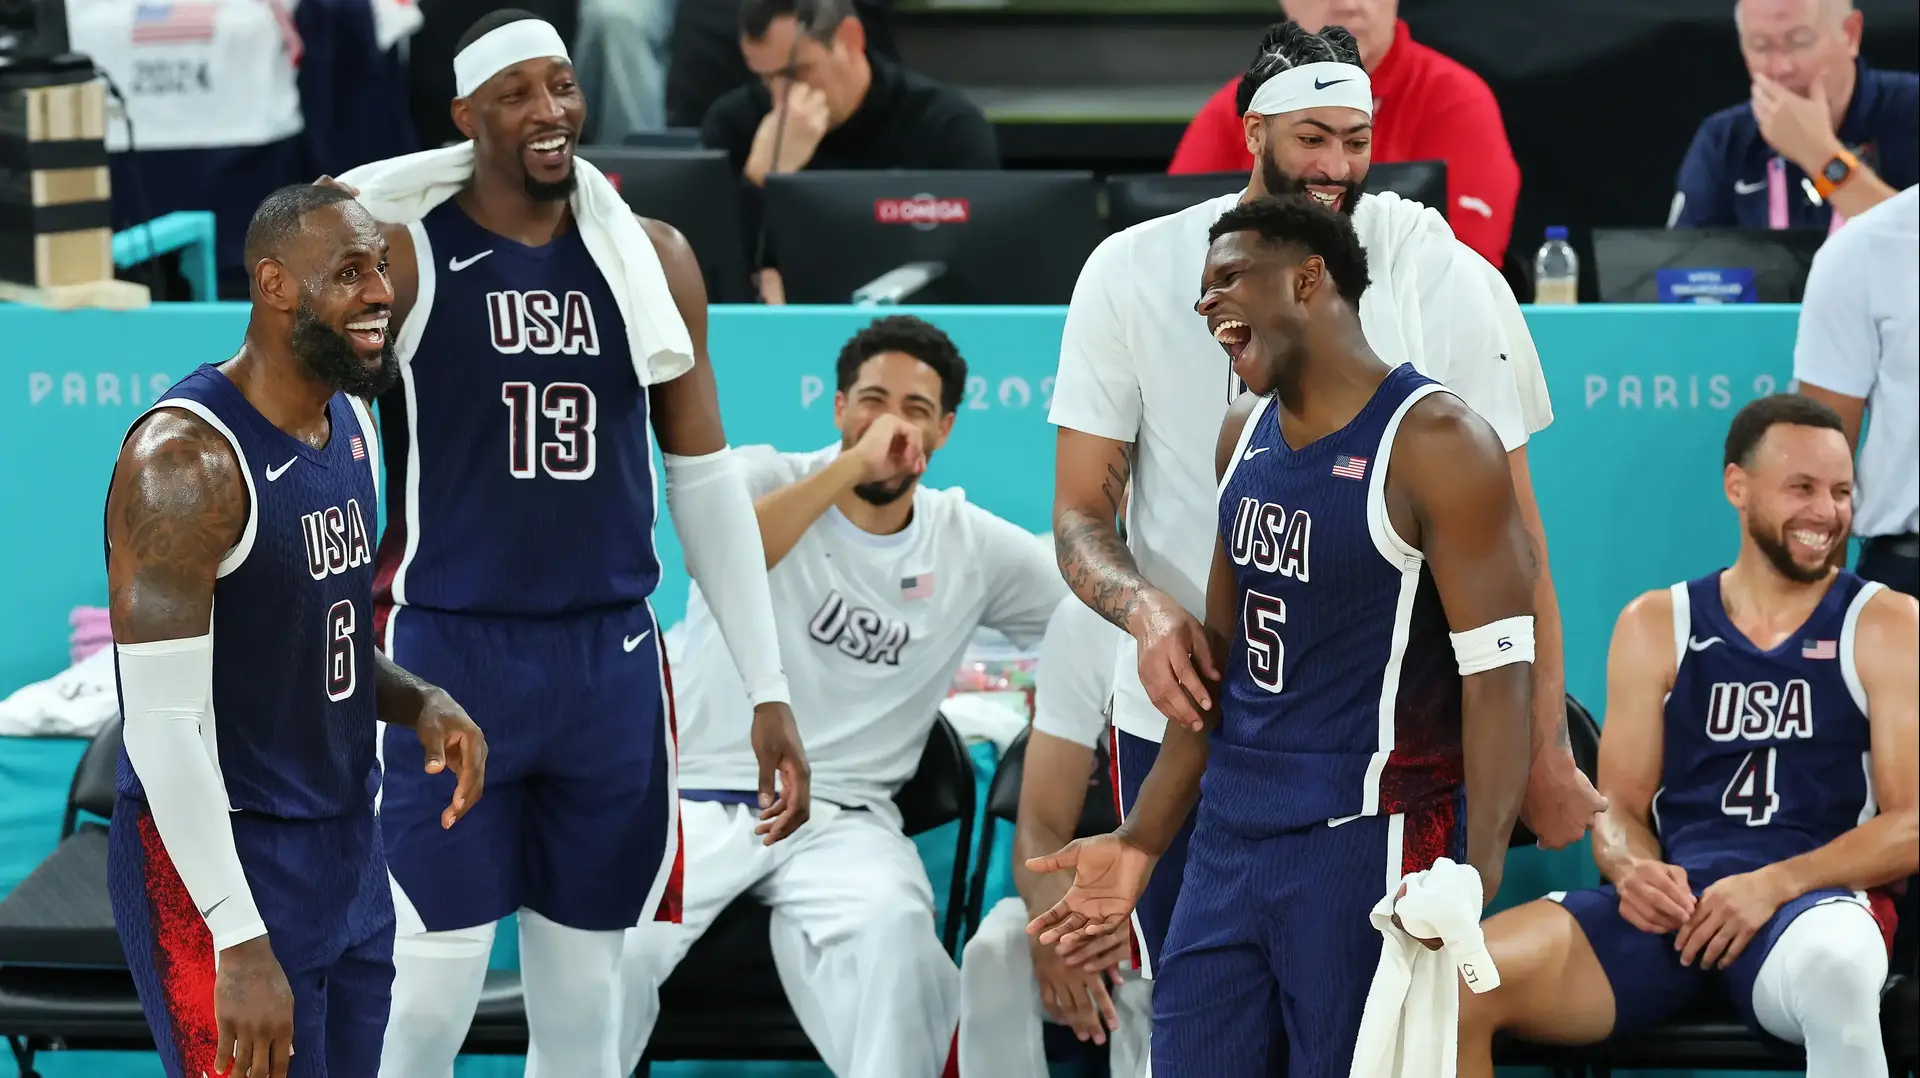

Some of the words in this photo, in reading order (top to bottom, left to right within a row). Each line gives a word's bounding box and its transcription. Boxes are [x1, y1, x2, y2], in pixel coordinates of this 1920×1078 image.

[486, 289, 600, 356] USA
[29, 371, 172, 406] PARIS
[1585, 374, 1731, 409] PARIS
[502, 382, 597, 480] 13
[301, 498, 371, 580] USA
[1231, 497, 1311, 583] USA
[326, 599, 356, 702] 6
[808, 589, 909, 666] USA
[1244, 588, 1286, 694] 5
[1497, 636, 1513, 652] 5
[1706, 679, 1813, 741] USA
[1721, 747, 1780, 827] 4
[1463, 963, 1479, 984] 5
